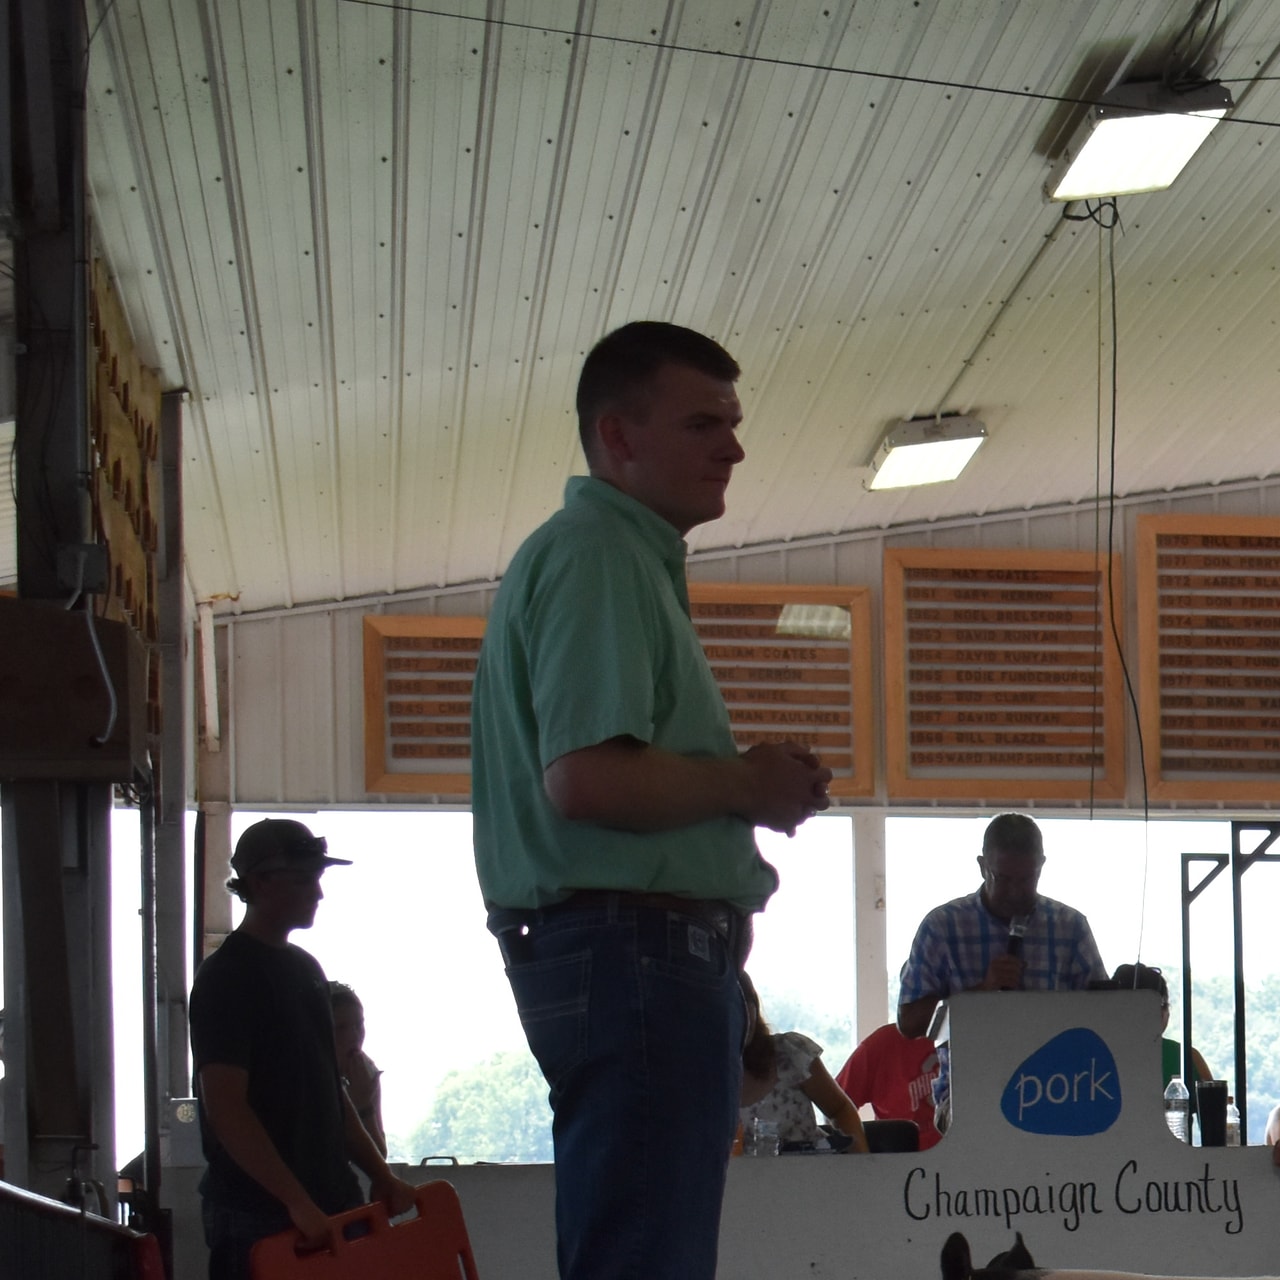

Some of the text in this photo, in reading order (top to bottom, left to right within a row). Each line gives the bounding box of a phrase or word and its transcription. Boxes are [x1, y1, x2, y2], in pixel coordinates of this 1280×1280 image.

[956, 630, 995, 640] DAVID
[1206, 637, 1245, 647] DAVID
[956, 651, 996, 661] DAVID
[957, 671, 994, 681] EDDIE
[1206, 698, 1245, 707] BRIAN
[958, 712, 997, 722] DAVID
[995, 733, 1046, 743] BLAZER
[1015, 1058, 1114, 1121] pork
[904, 1160, 1245, 1234] Champaign County
